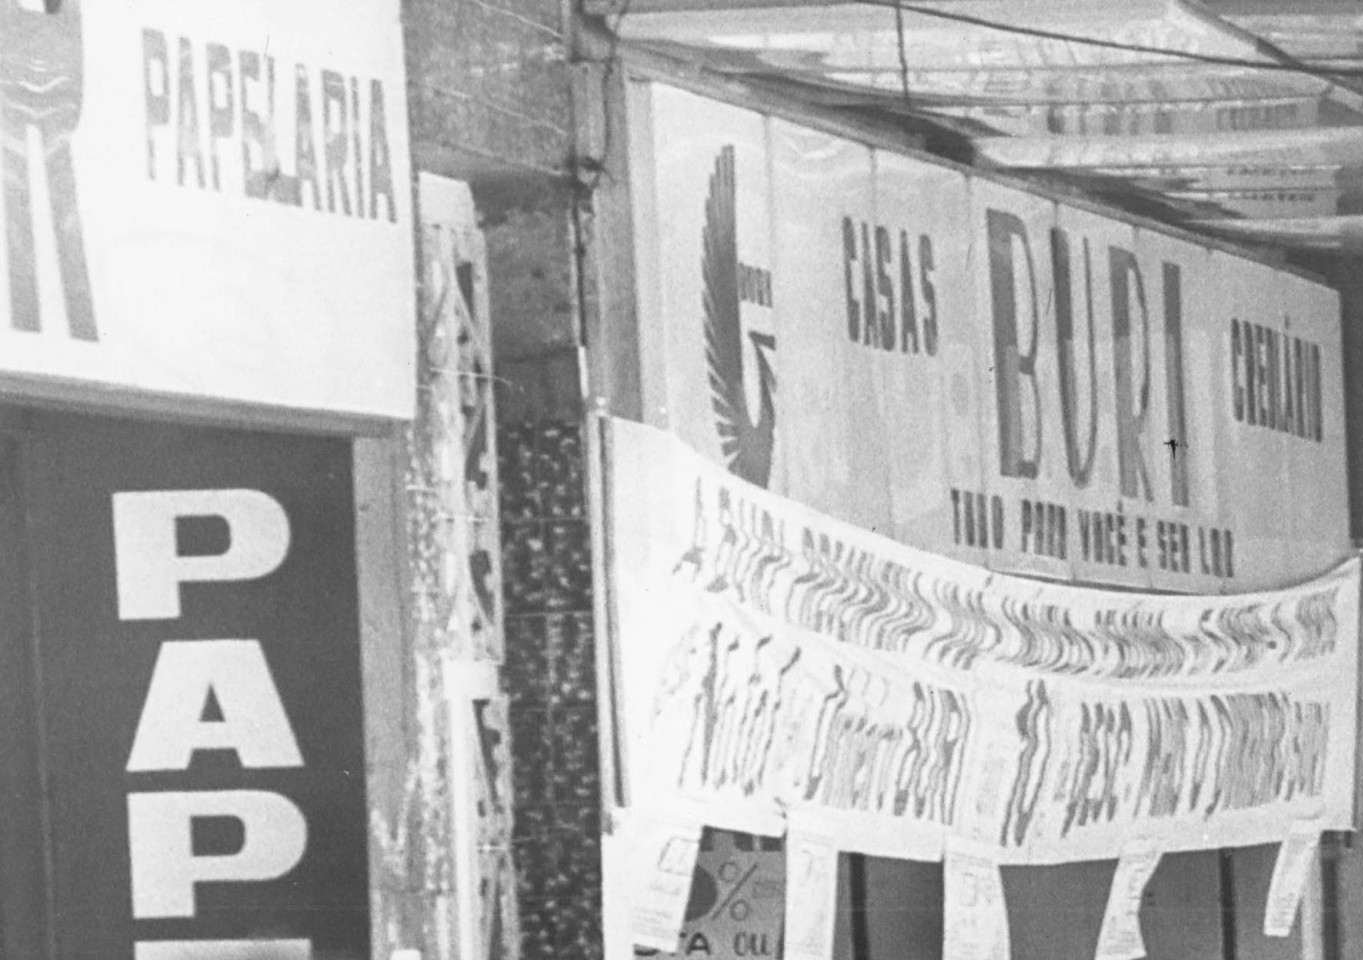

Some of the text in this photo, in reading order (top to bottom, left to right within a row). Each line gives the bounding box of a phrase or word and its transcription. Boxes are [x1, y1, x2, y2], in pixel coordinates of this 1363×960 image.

[141, 28, 398, 224] PAPELARIA
[842, 216, 939, 357] CASAS
[987, 207, 1190, 507] BURI
[951, 487, 1004, 550] TUDO
[1021, 499, 1067, 560] PARA
[1136, 517, 1148, 569] E
